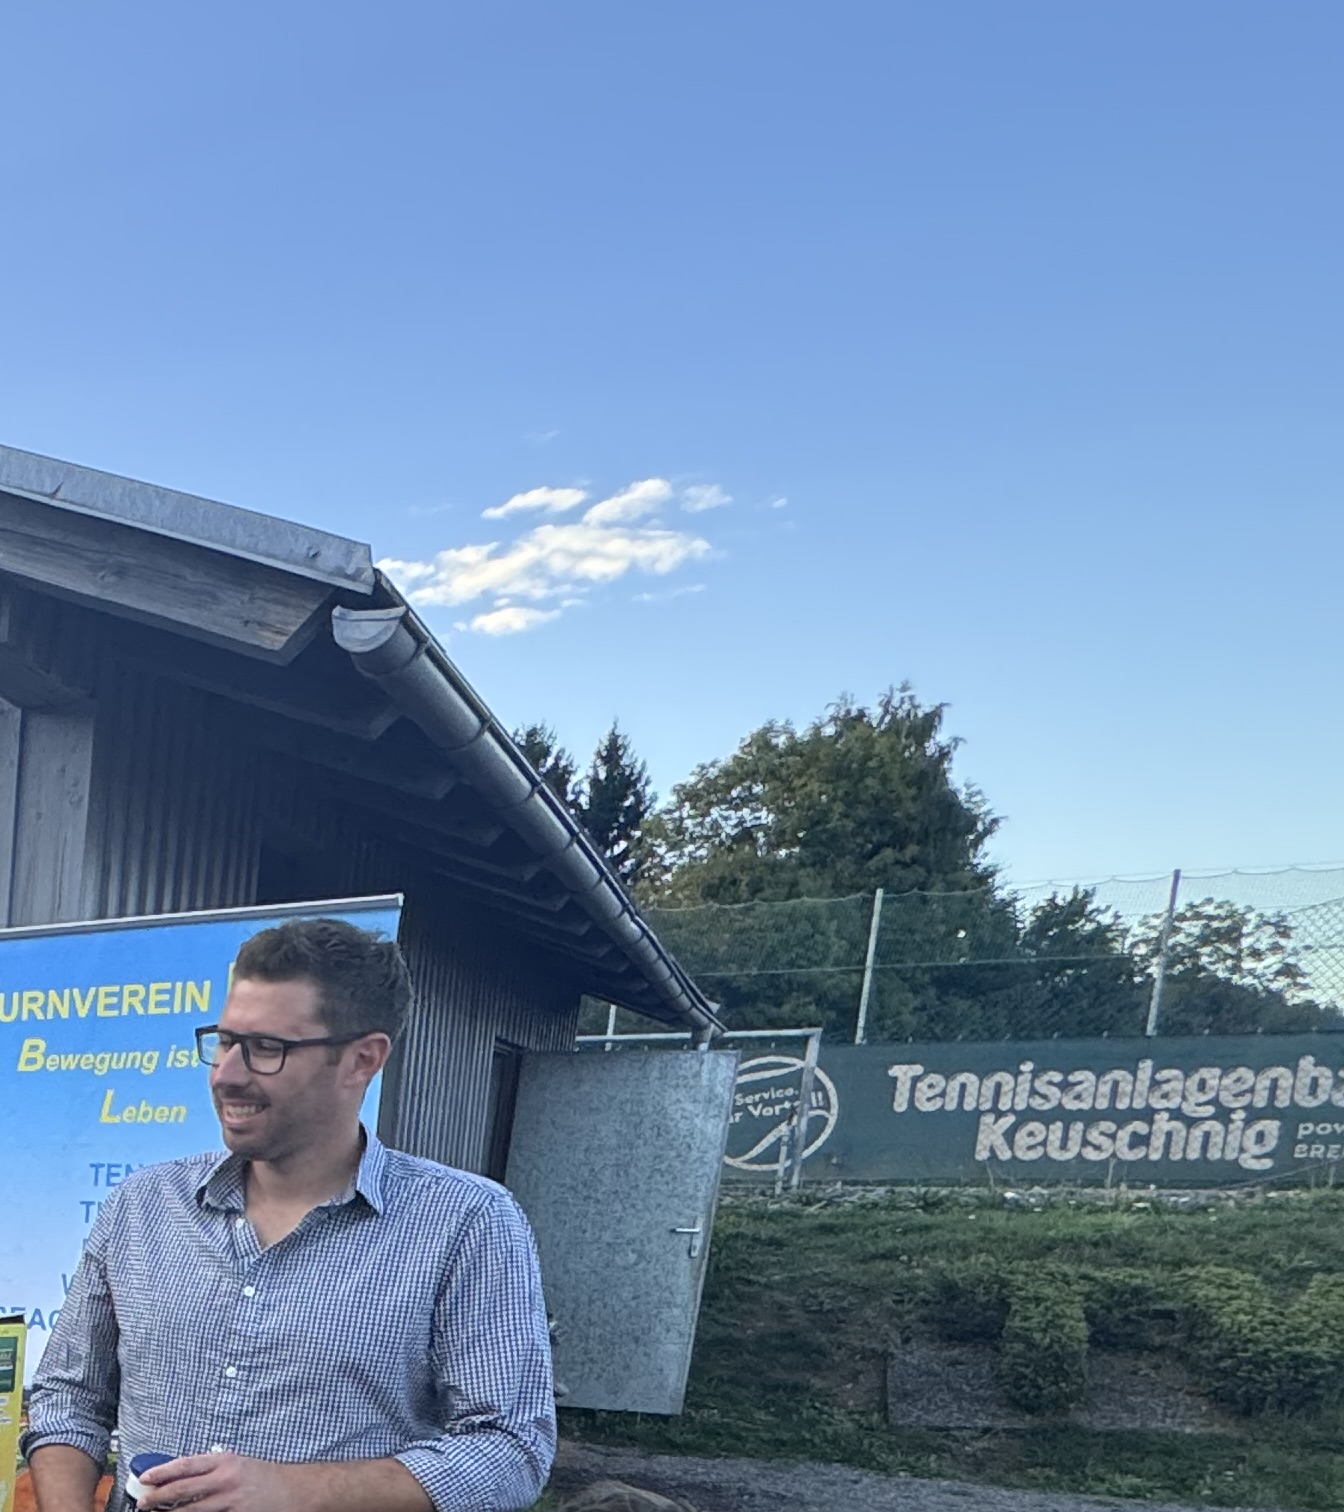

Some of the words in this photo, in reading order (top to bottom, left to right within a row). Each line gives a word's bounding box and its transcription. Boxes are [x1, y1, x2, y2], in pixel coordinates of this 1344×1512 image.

[17, 1038, 159, 1075] Bewegung
[166, 1045, 199, 1068] ist
[100, 1088, 187, 1123] Leben
[974, 1110, 1282, 1171] Keuschnig
